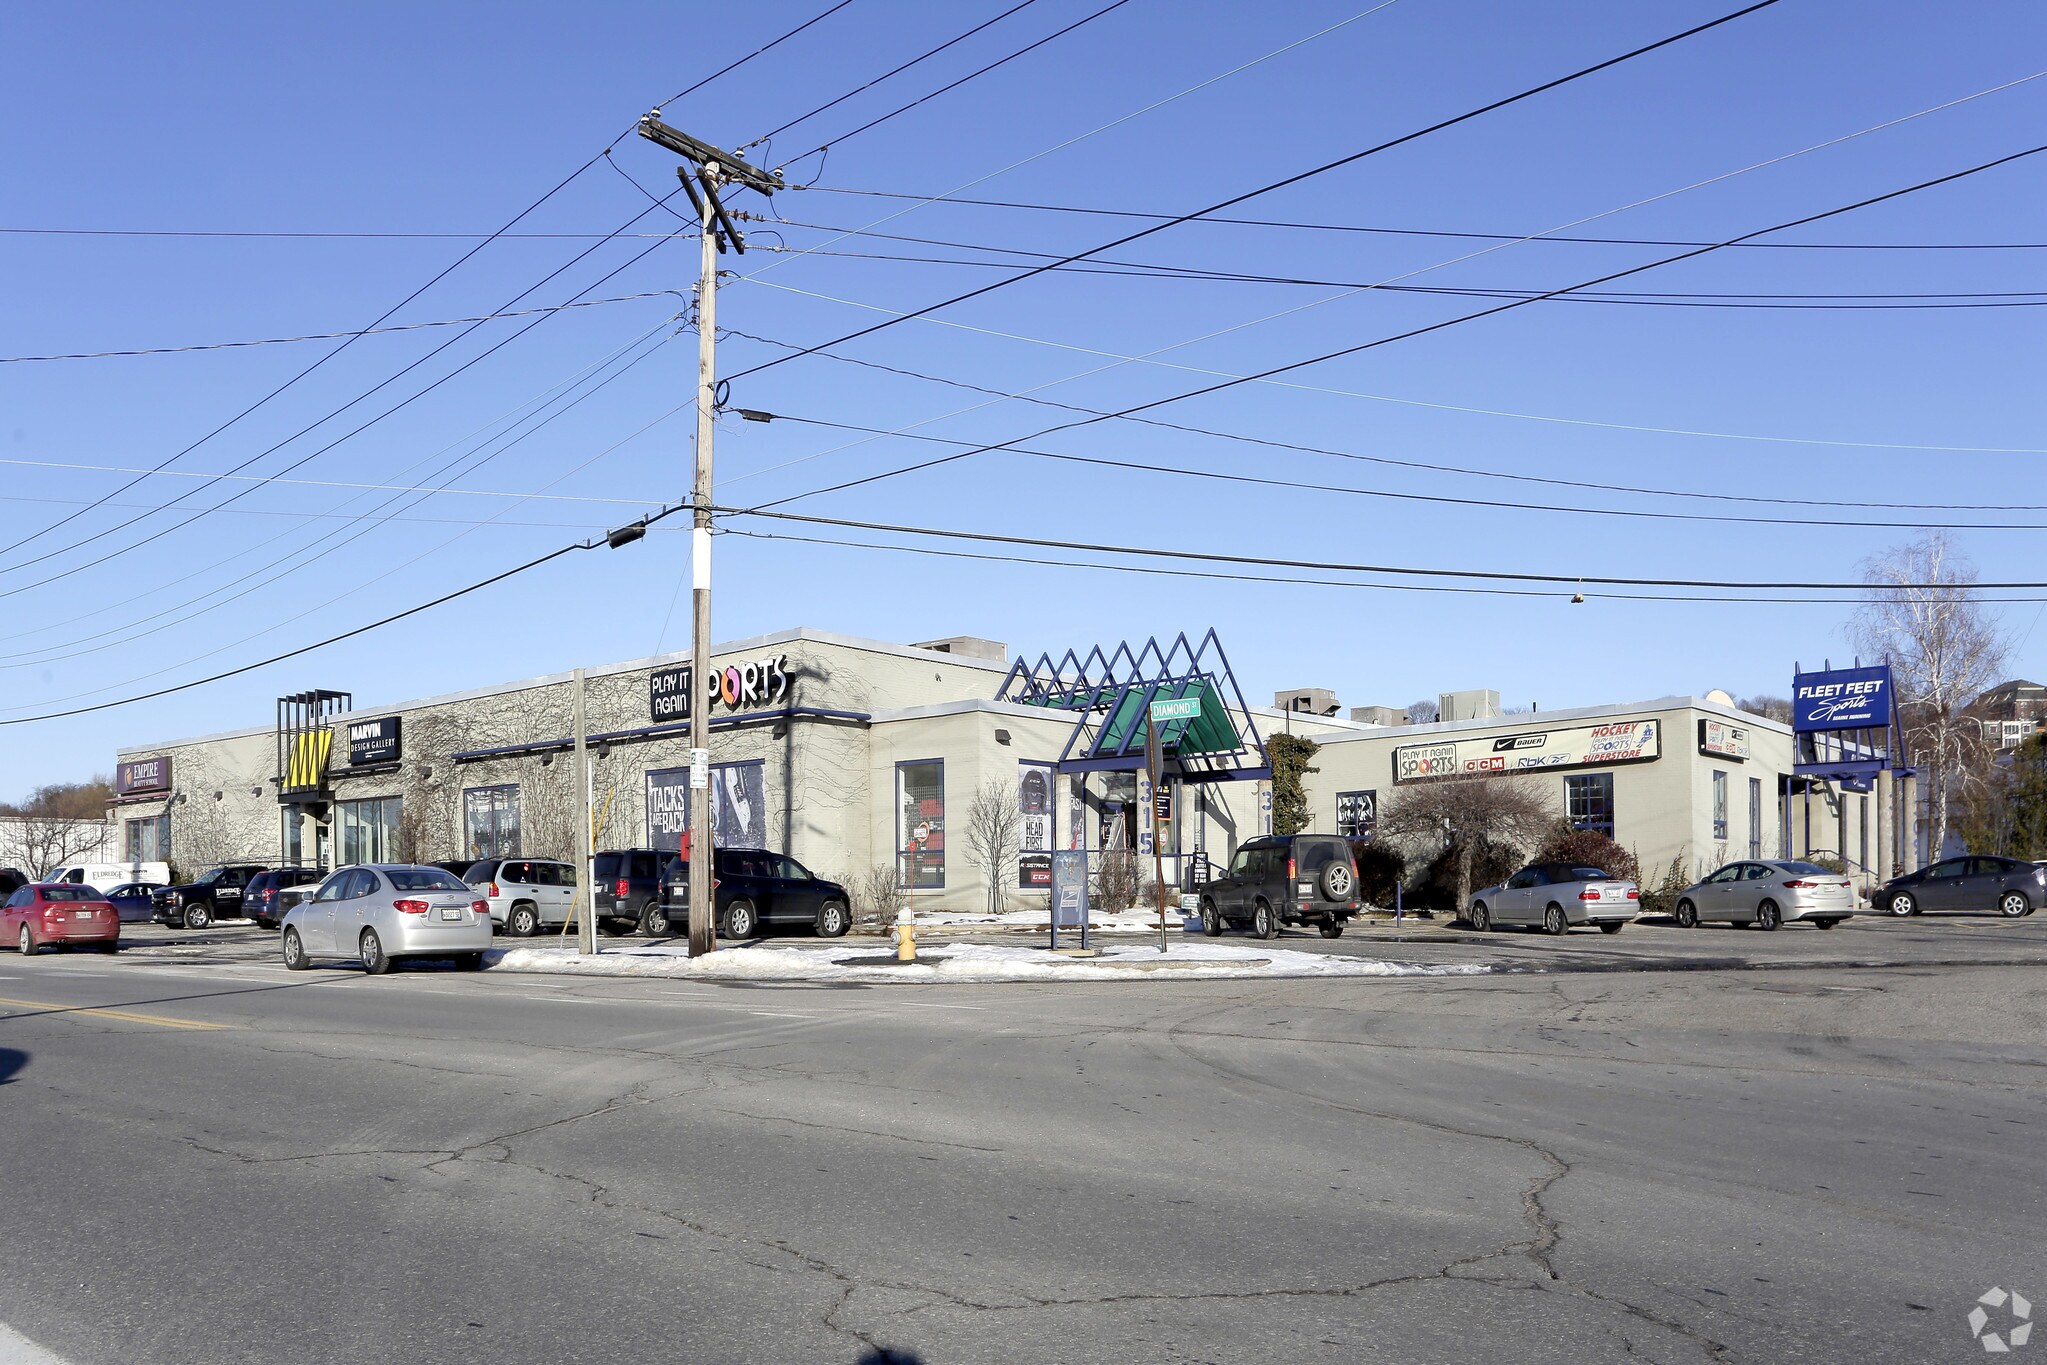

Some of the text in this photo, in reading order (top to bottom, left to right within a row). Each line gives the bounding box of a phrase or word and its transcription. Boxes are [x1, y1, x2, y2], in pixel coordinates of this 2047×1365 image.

[652, 671, 689, 694] PLAY IT
[708, 654, 787, 706] PORTS
[1798, 680, 1884, 699] FLEET FEET
[655, 693, 687, 715] AGAIN
[1153, 701, 1197, 717] DIAMOND ST
[1808, 695, 1874, 721] Sports
[351, 722, 381, 741] MARVIN
[1591, 722, 1640, 738] HOCKEY
[350, 737, 396, 753] DESIGN GALLERY
[1516, 738, 1543, 746] BAUER
[1592, 739, 1630, 753] SPORTS
[691, 752, 696, 765] 2
[1402, 746, 1454, 760] PLAY IT AGAIN
[1582, 748, 1642, 763] SUPERSTORE
[133, 761, 159, 779] EMPIRE
[1401, 756, 1455, 776] SPORTS
[1465, 758, 1504, 771] CCM
[652, 785, 685, 812] TACKS
[652, 811, 685, 834] ARE BACK
[1140, 780, 1153, 855] 315
[1025, 821, 1044, 837] HEAD
[1025, 836, 1044, 851] FIRST
[92, 870, 124, 881] ELDREDGE
[1031, 873, 1051, 881] CCM
